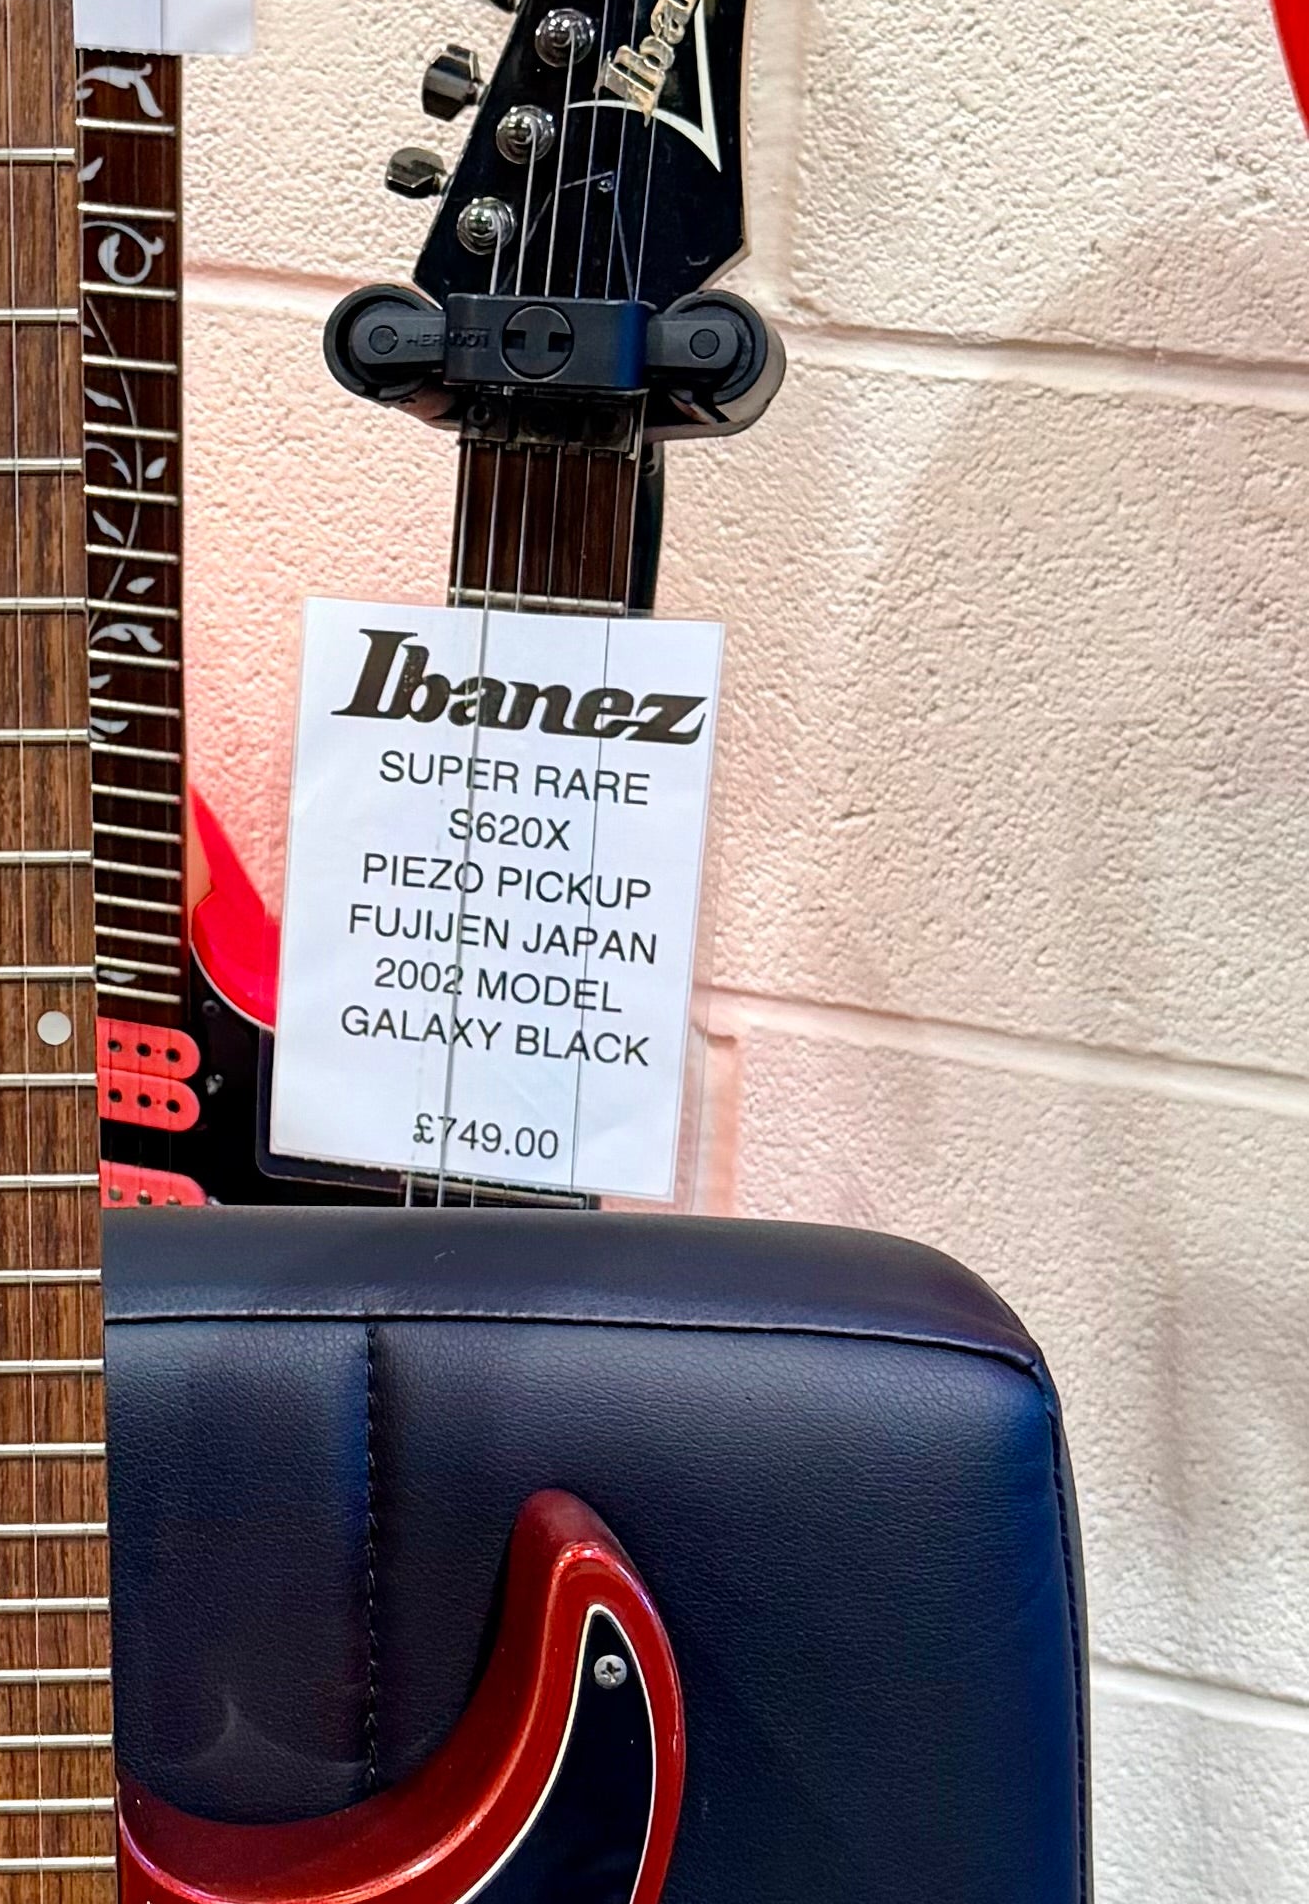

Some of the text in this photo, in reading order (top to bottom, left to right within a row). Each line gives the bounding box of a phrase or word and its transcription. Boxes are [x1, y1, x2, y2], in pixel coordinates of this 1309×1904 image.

[331, 628, 709, 745] Ibanez
[379, 750, 651, 806] SUPER RARE
[448, 809, 571, 851] S620X
[362, 852, 652, 910] PIEZO PICKUP
[348, 903, 657, 964] FUJIJEN JAPAN
[374, 957, 623, 1013] 2002 MODEL
[340, 1005, 650, 1067] GALAXY BLACK
[412, 1113, 559, 1160] £749.00
